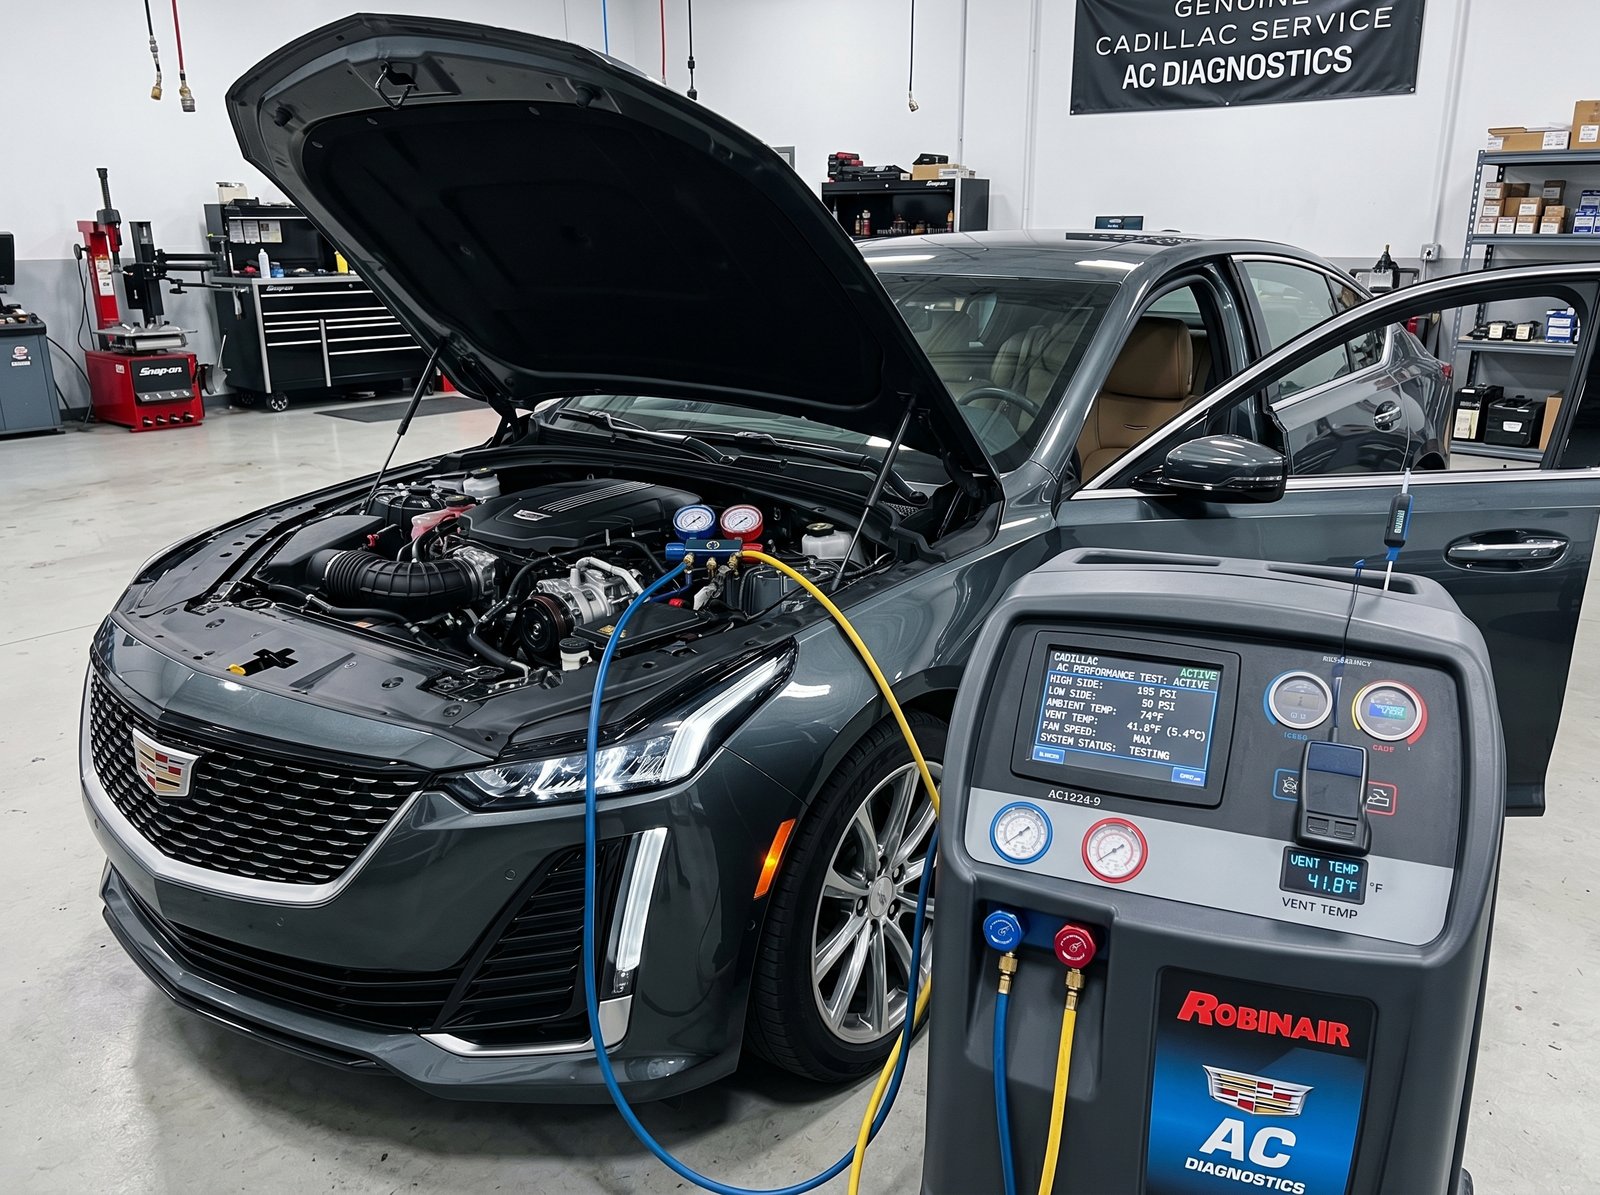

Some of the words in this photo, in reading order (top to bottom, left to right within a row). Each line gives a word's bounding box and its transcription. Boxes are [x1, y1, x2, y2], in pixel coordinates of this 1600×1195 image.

[1174, 0, 1309, 18] GENU
[1095, 24, 1238, 56] CADILLAC
[1250, 6, 1393, 42] SERVICE
[1122, 64, 1156, 90] AC
[1163, 45, 1353, 86] DIAGNOSTICS
[1054, 652, 1099, 666] CADILLAC
[1180, 668, 1218, 681] ACTIVE
[1056, 663, 1069, 672] AC
[1073, 665, 1136, 681] PERFORMANCE
[1140, 673, 1168, 685] TEST:
[1173, 677, 1210, 690] ACTIVE
[1048, 686, 1066, 697] LOW
[1069, 689, 1096, 701] SIDE:
[1141, 698, 1154, 709] 50
[1158, 700, 1176, 712] PSI
[1050, 674, 1073, 685] HIGH
[1076, 677, 1104, 690] SIDE:
[1159, 688, 1177, 699] PSI
[1046, 697, 1086, 711] AMBIENT
[1090, 703, 1117, 716] TEMP:
[1140, 710, 1165, 722] 74°F
[1042, 721, 1060, 731] FAN
[1063, 724, 1096, 737] SPEED:
[1132, 733, 1152, 746] MAX
[1045, 709, 1068, 720] VENT
[1072, 712, 1099, 725] TEMP:
[1126, 721, 1162, 734] 41.8°F
[1166, 726, 1206, 742] (5.4°C)
[1040, 732, 1075, 746] SYSTEM
[1077, 738, 1117, 752] STATUS:
[1129, 745, 1170, 760] TESTING
[1047, 789, 1102, 806] AC1224-9
[1290, 854, 1320, 869] VENT
[1328, 860, 1359, 875] TEMP
[1308, 873, 1358, 893] 41.8°F
[1369, 881, 1384, 893] °F
[1282, 896, 1317, 912] VENT
[1320, 903, 1358, 919] TEMP
[1199, 1117, 1297, 1169] AC
[1184, 1156, 1306, 1195] DIAGNOSTICS
